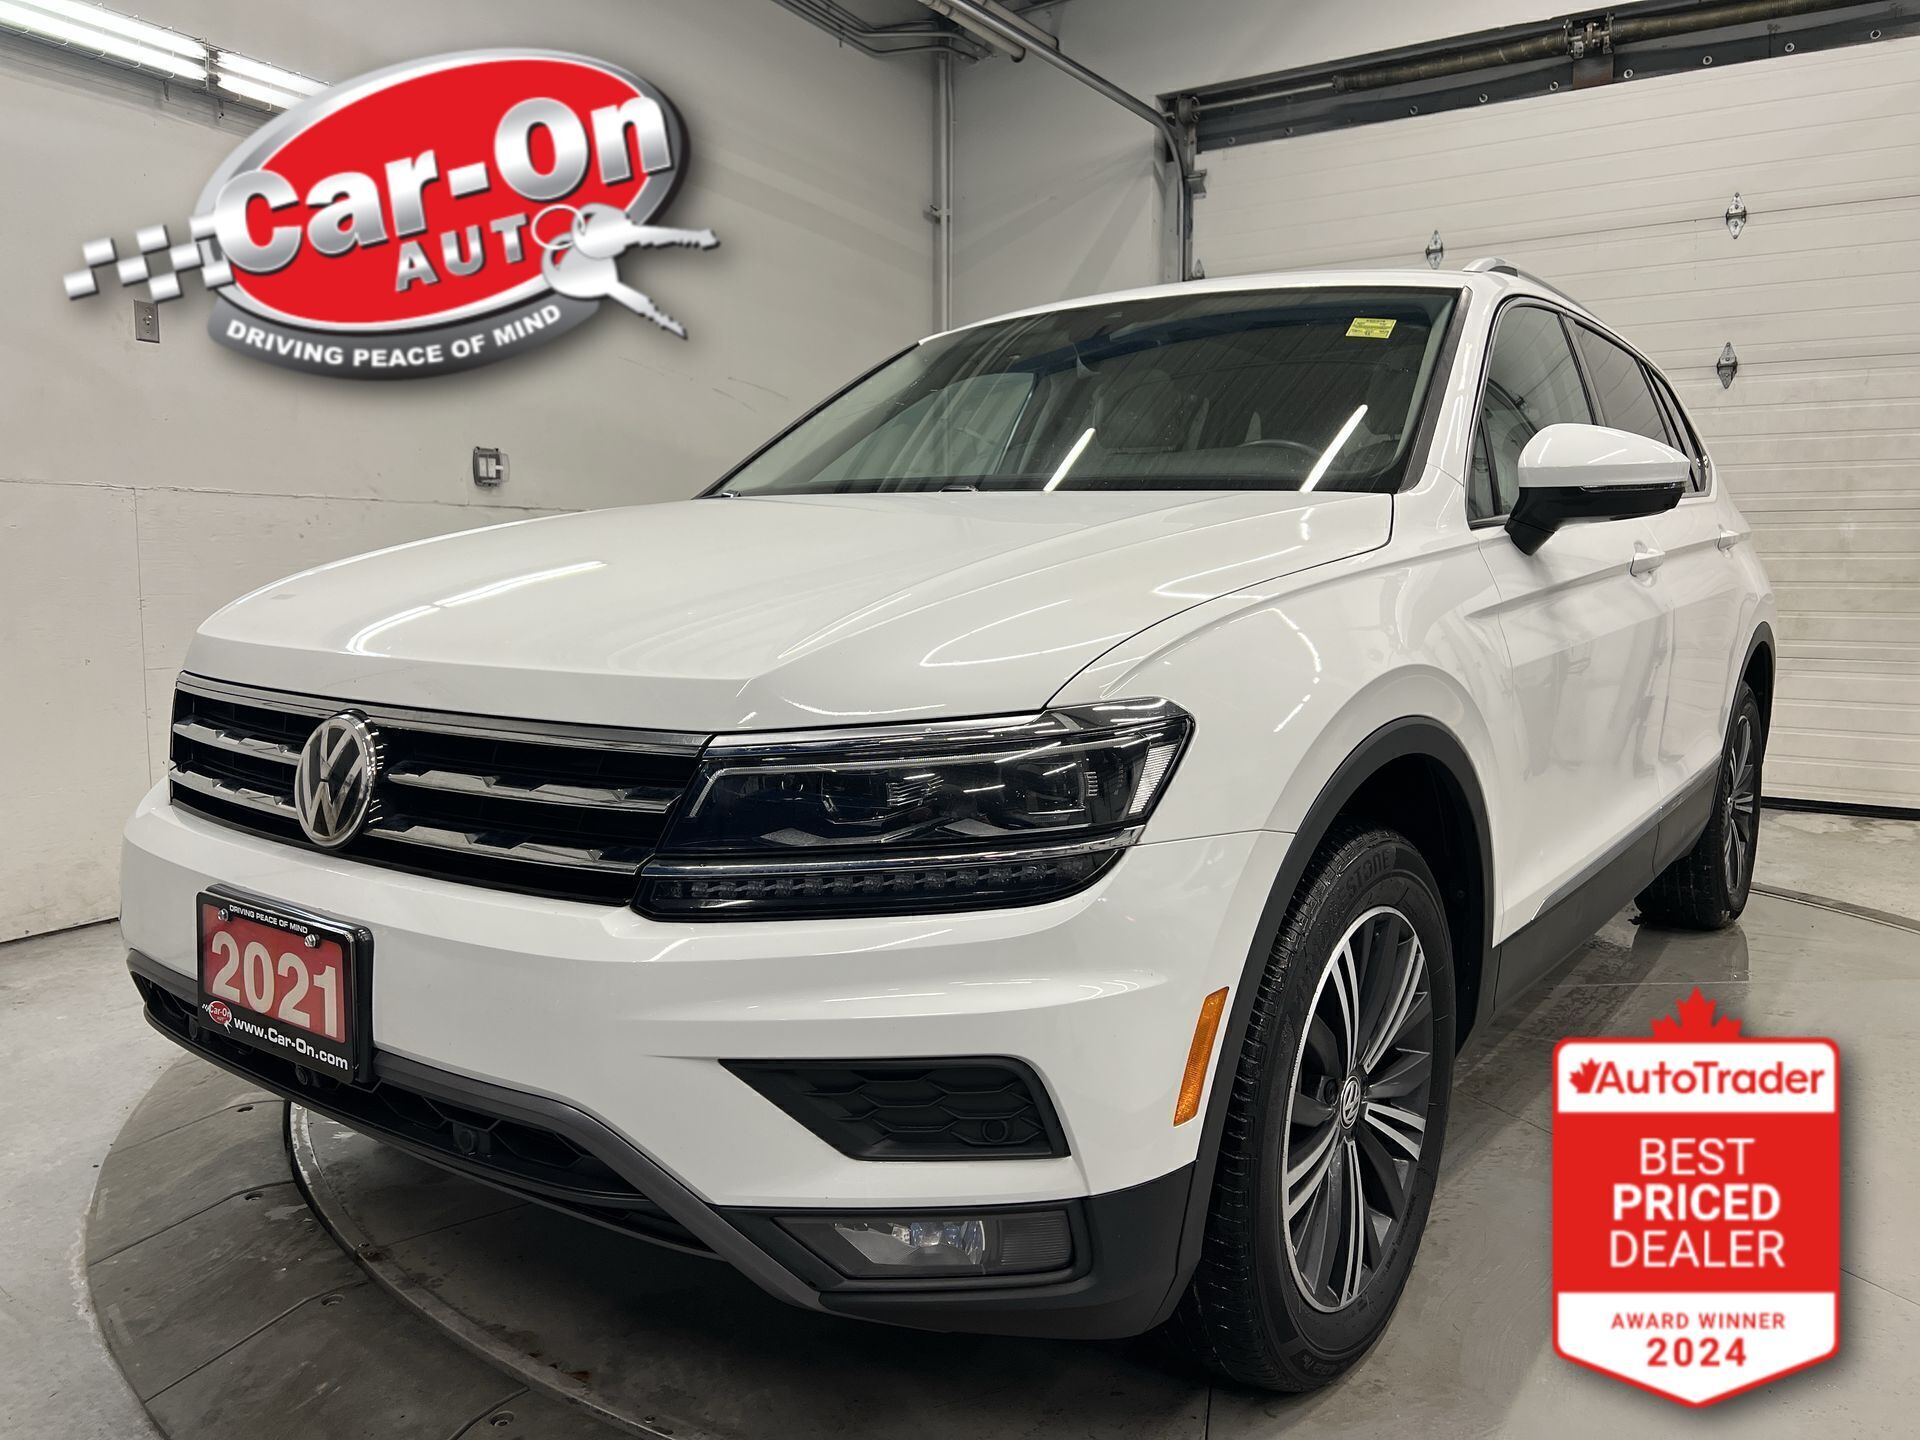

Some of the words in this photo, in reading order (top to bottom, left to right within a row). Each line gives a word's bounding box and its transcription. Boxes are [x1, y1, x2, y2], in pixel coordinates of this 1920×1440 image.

[229, 904, 254, 918] DRIVING
[255, 912, 278, 926] PEACE
[278, 919, 288, 928] OF
[289, 922, 308, 934] MIND
[211, 930, 337, 1039] 2021
[209, 1004, 231, 1018] Car-On
[234, 1017, 349, 1071] www.Car-On.com
